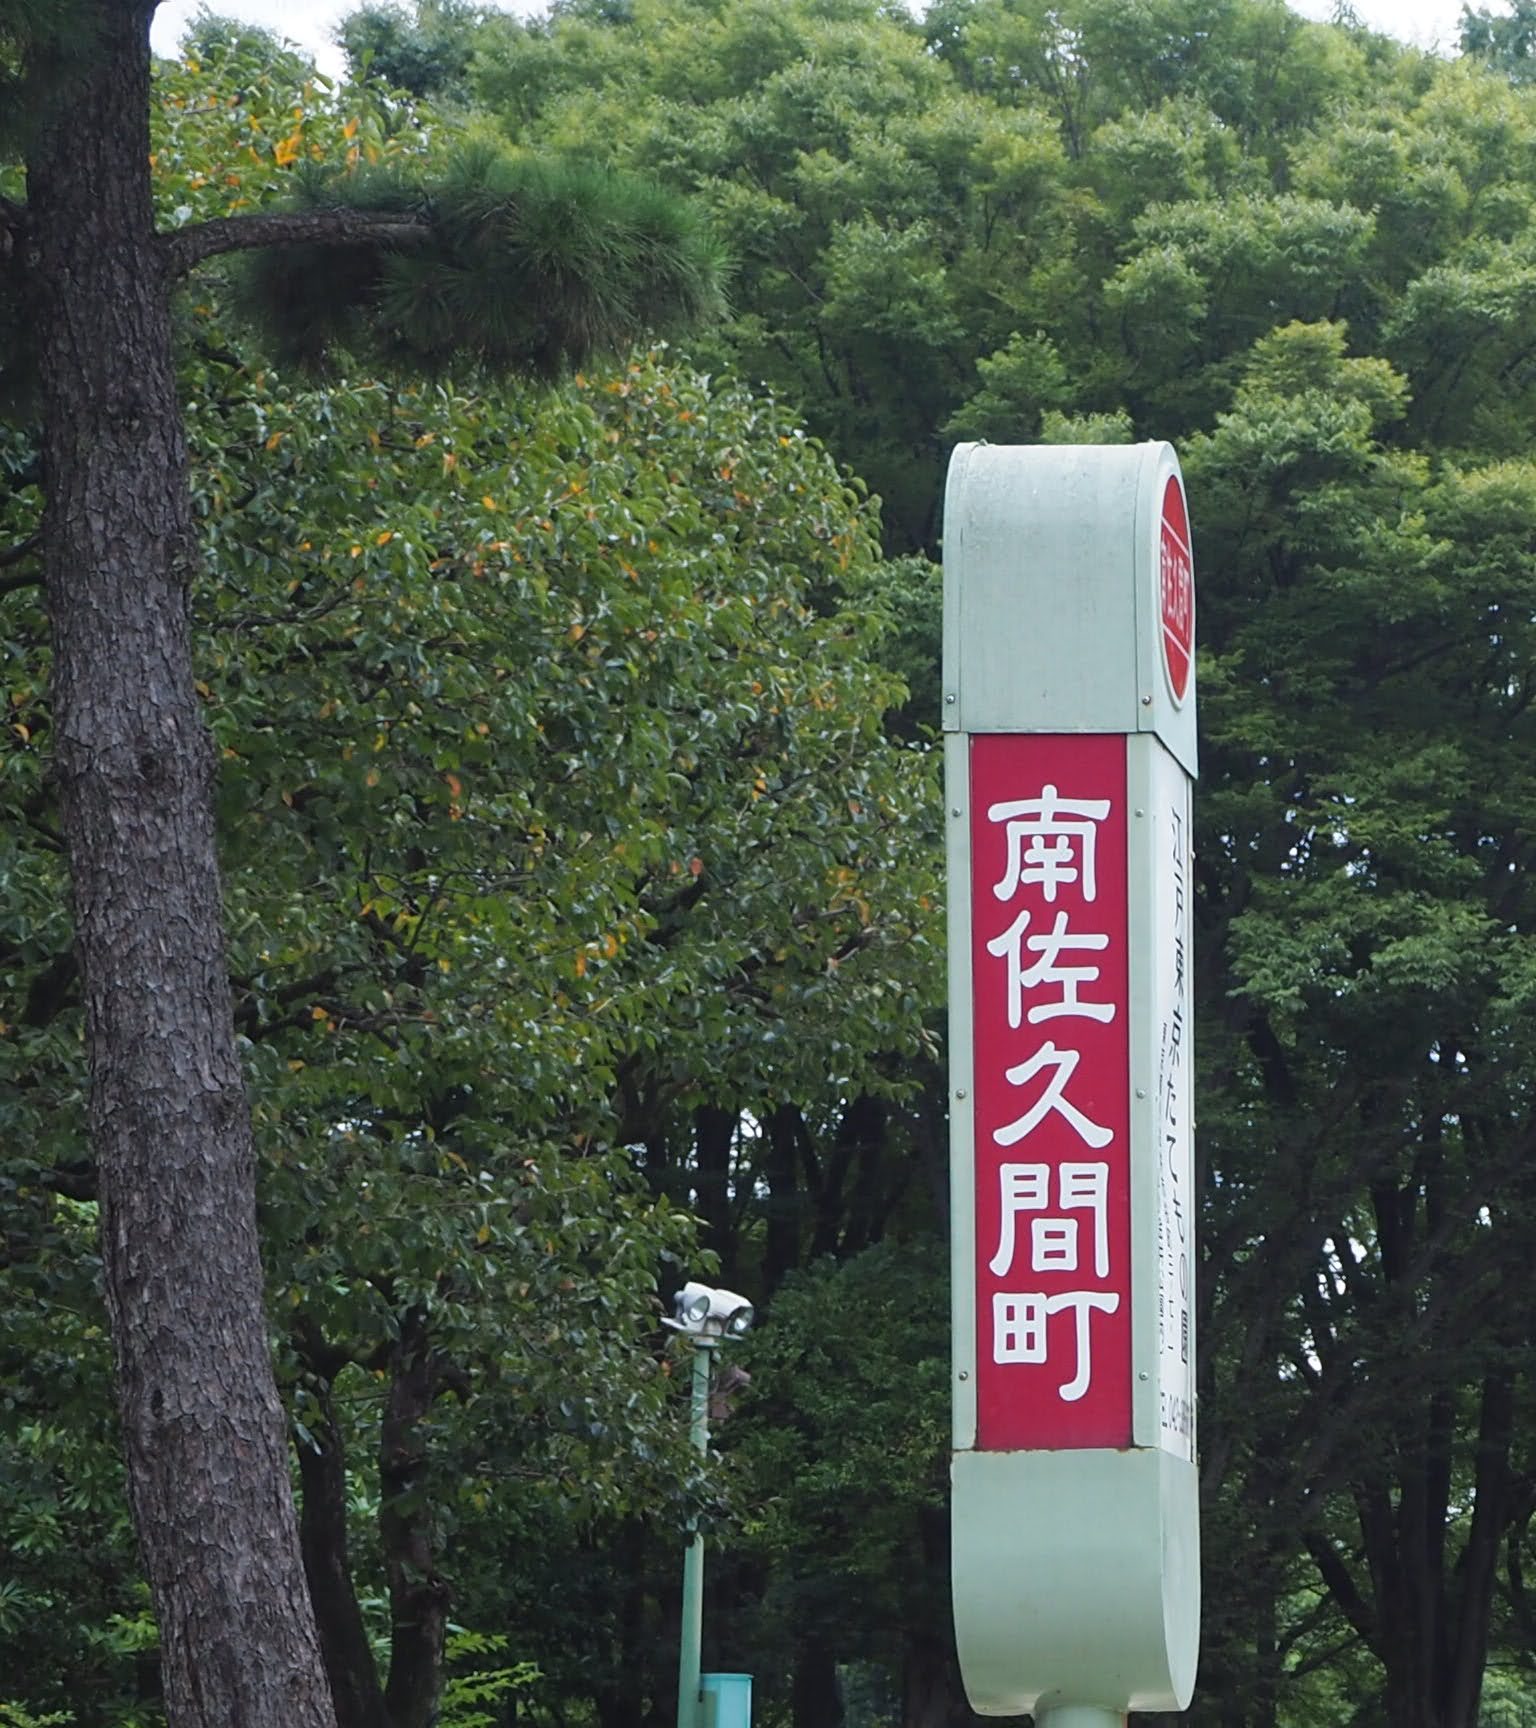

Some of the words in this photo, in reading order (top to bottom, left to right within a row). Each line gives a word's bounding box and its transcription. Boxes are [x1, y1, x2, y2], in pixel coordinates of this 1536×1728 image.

[986, 783, 1121, 1403] 南佐久間町
